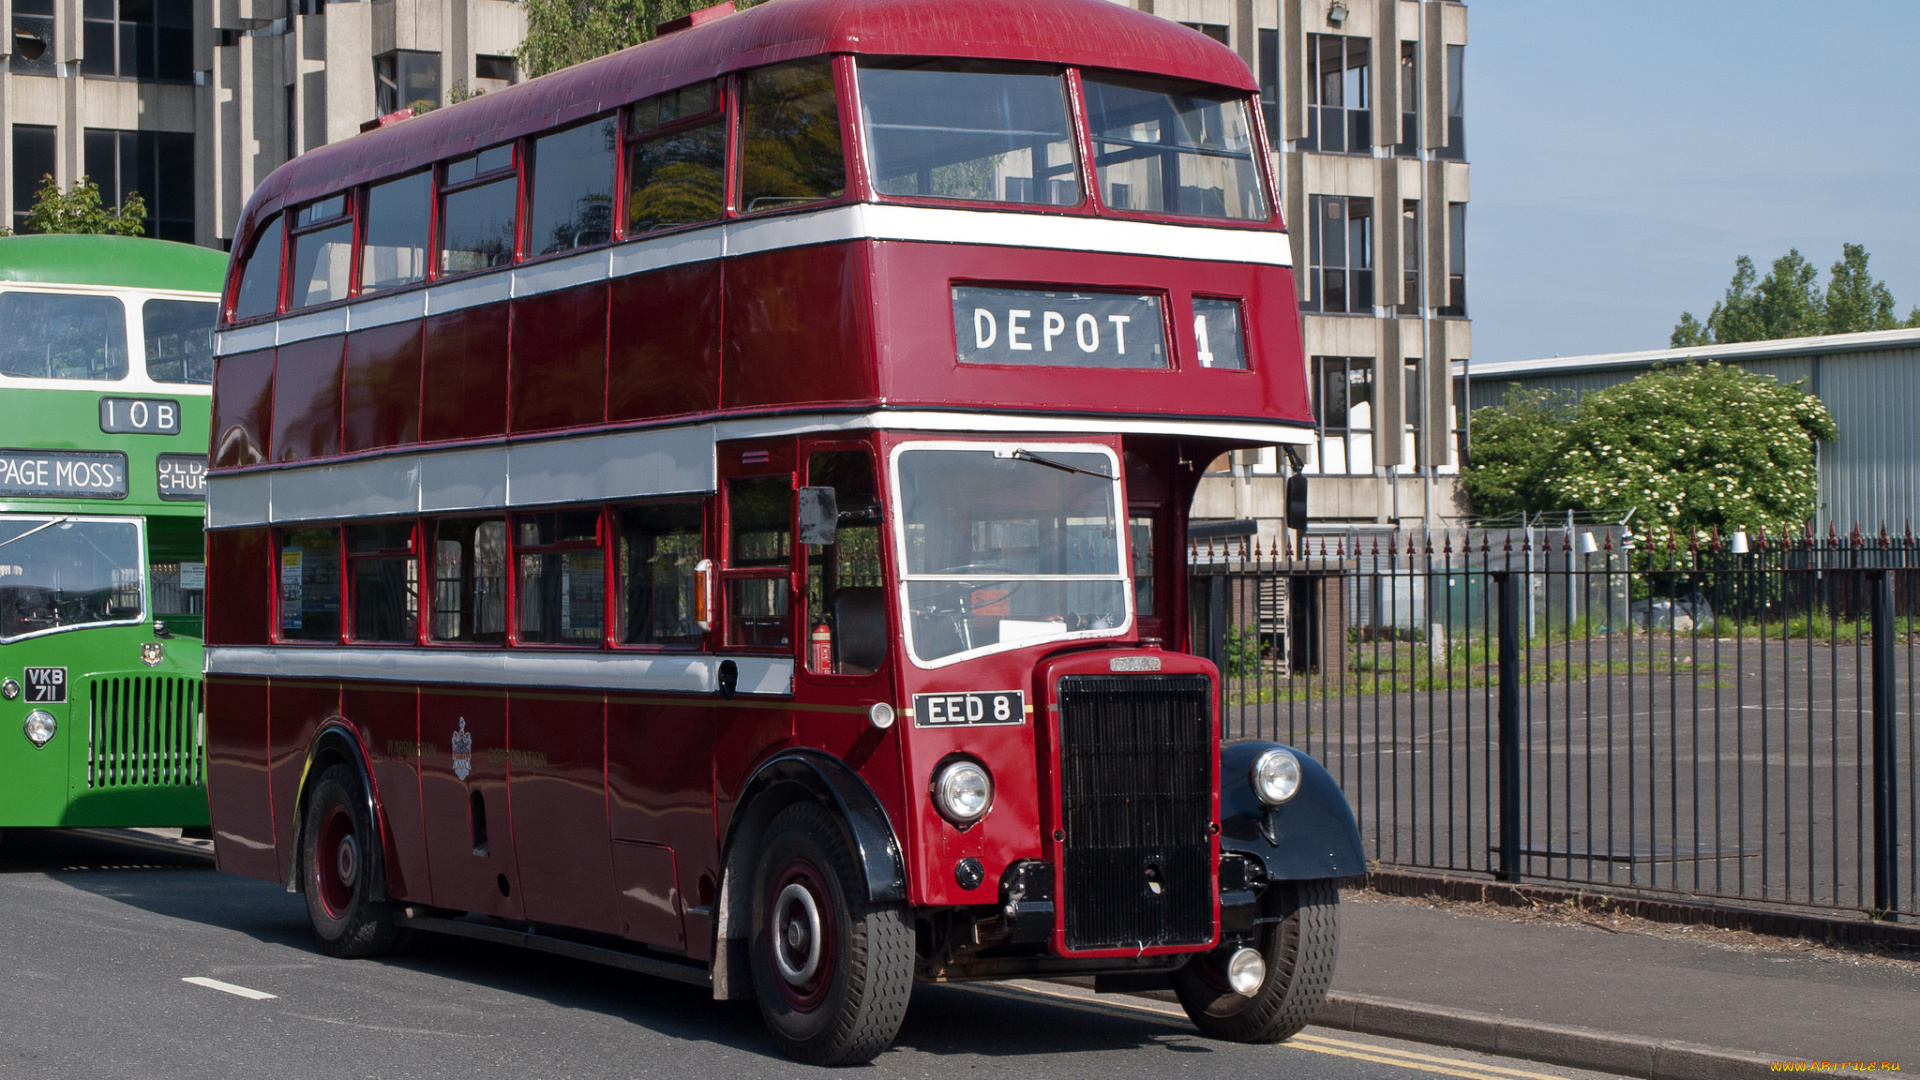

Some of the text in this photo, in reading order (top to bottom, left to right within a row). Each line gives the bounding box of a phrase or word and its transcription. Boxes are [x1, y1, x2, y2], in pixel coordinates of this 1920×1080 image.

[974, 307, 1131, 354] DEPOT
[56, 461, 114, 488] MOSS
[158, 460, 202, 474] OLD
[28, 669, 63, 685] VKB
[35, 685, 56, 701] 711
[928, 695, 1010, 723] EED 8
